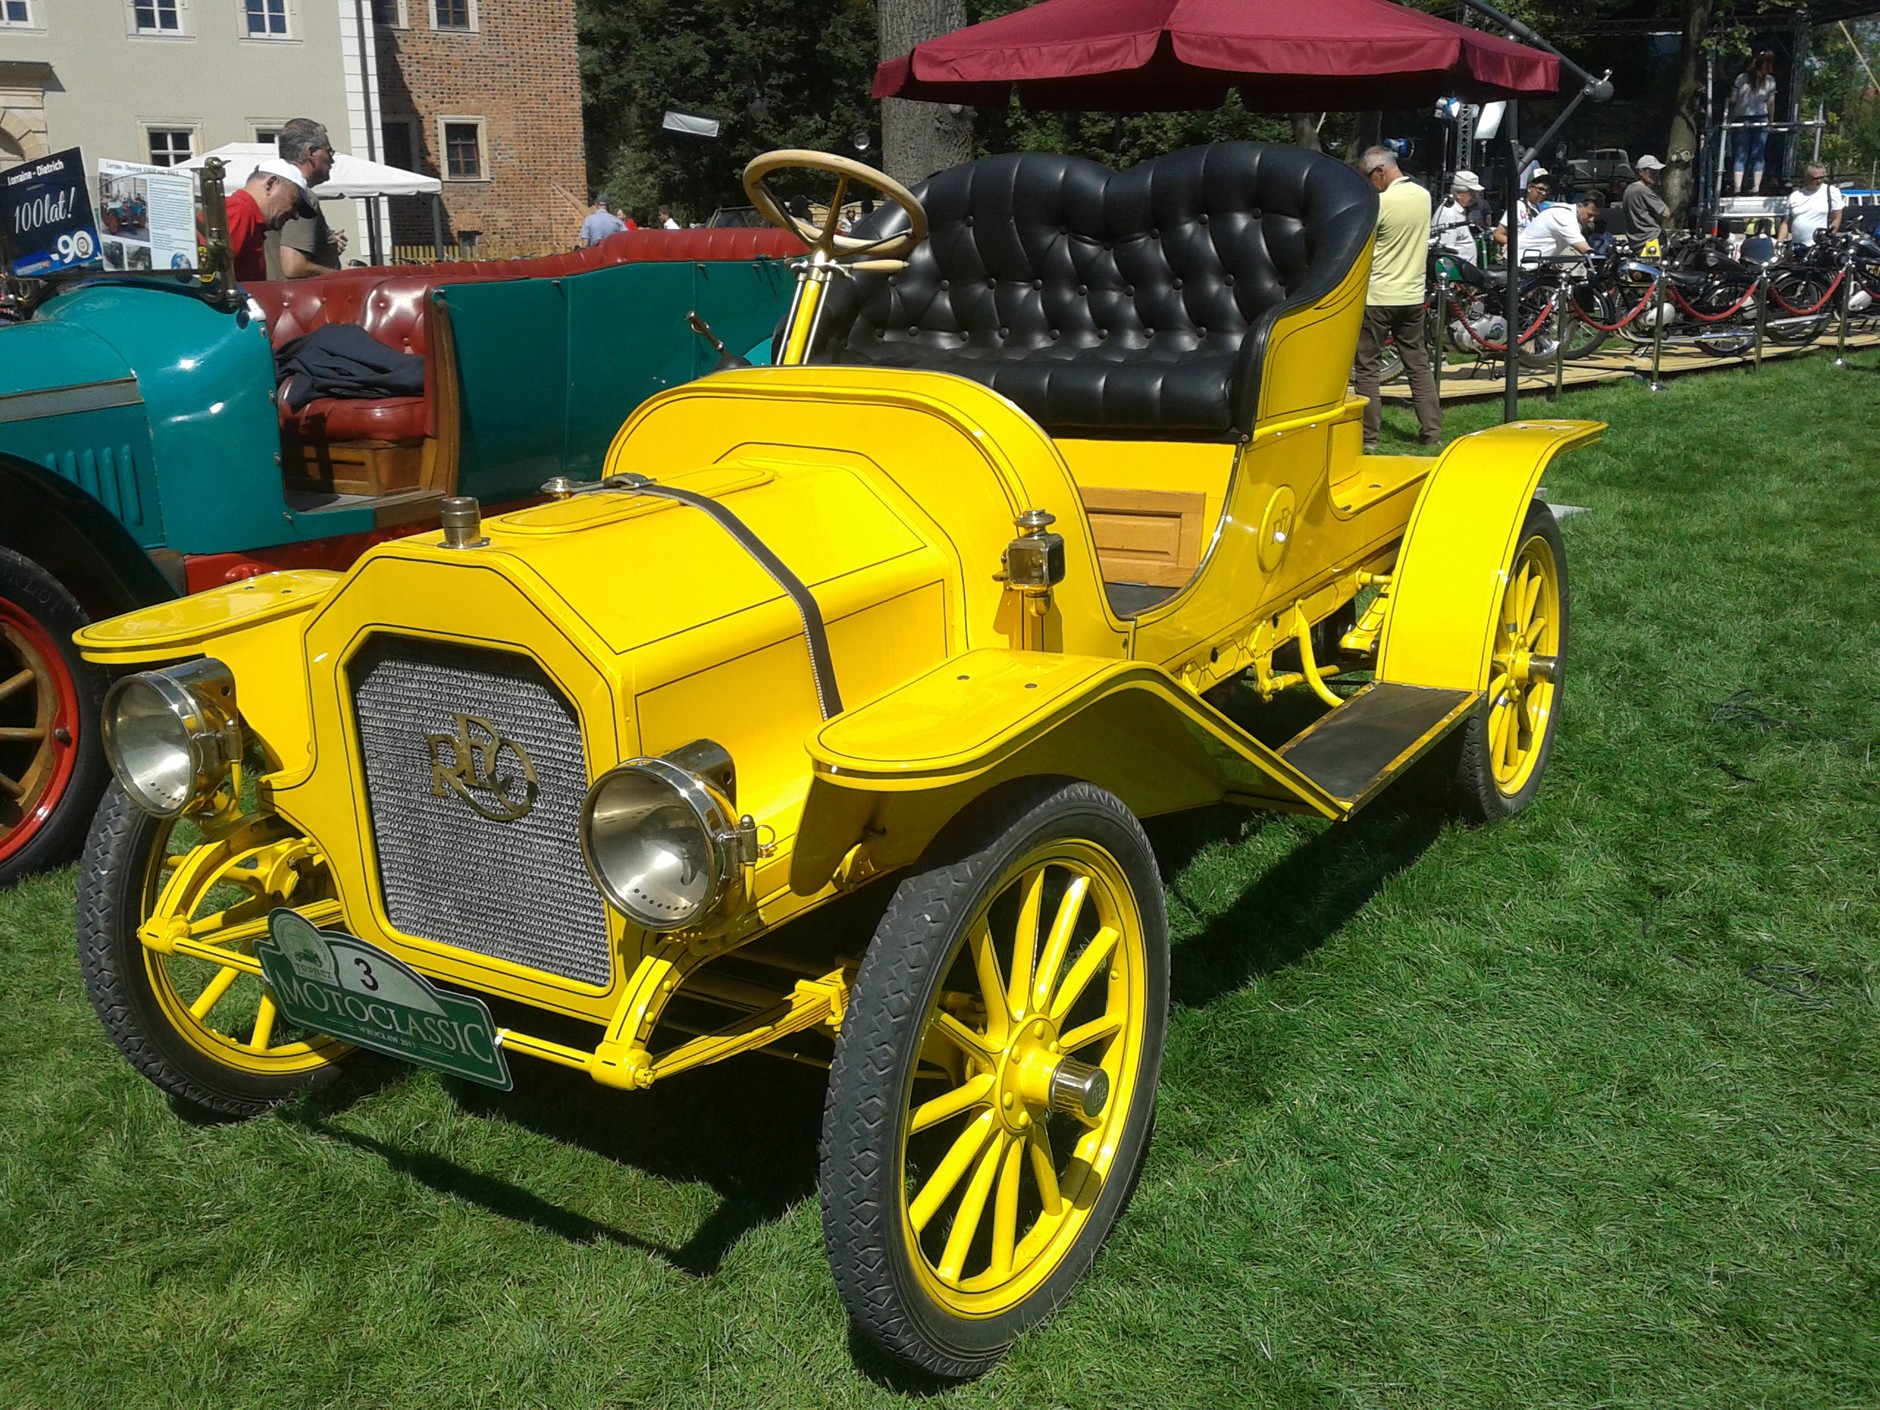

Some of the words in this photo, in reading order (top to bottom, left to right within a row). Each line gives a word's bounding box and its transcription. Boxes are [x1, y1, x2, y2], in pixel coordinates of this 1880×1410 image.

[7, 171, 33, 186] Lorraine
[36, 160, 64, 176] Dietrich
[353, 957, 379, 991] 3
[275, 968, 493, 1064] MOTOCLASSIC
